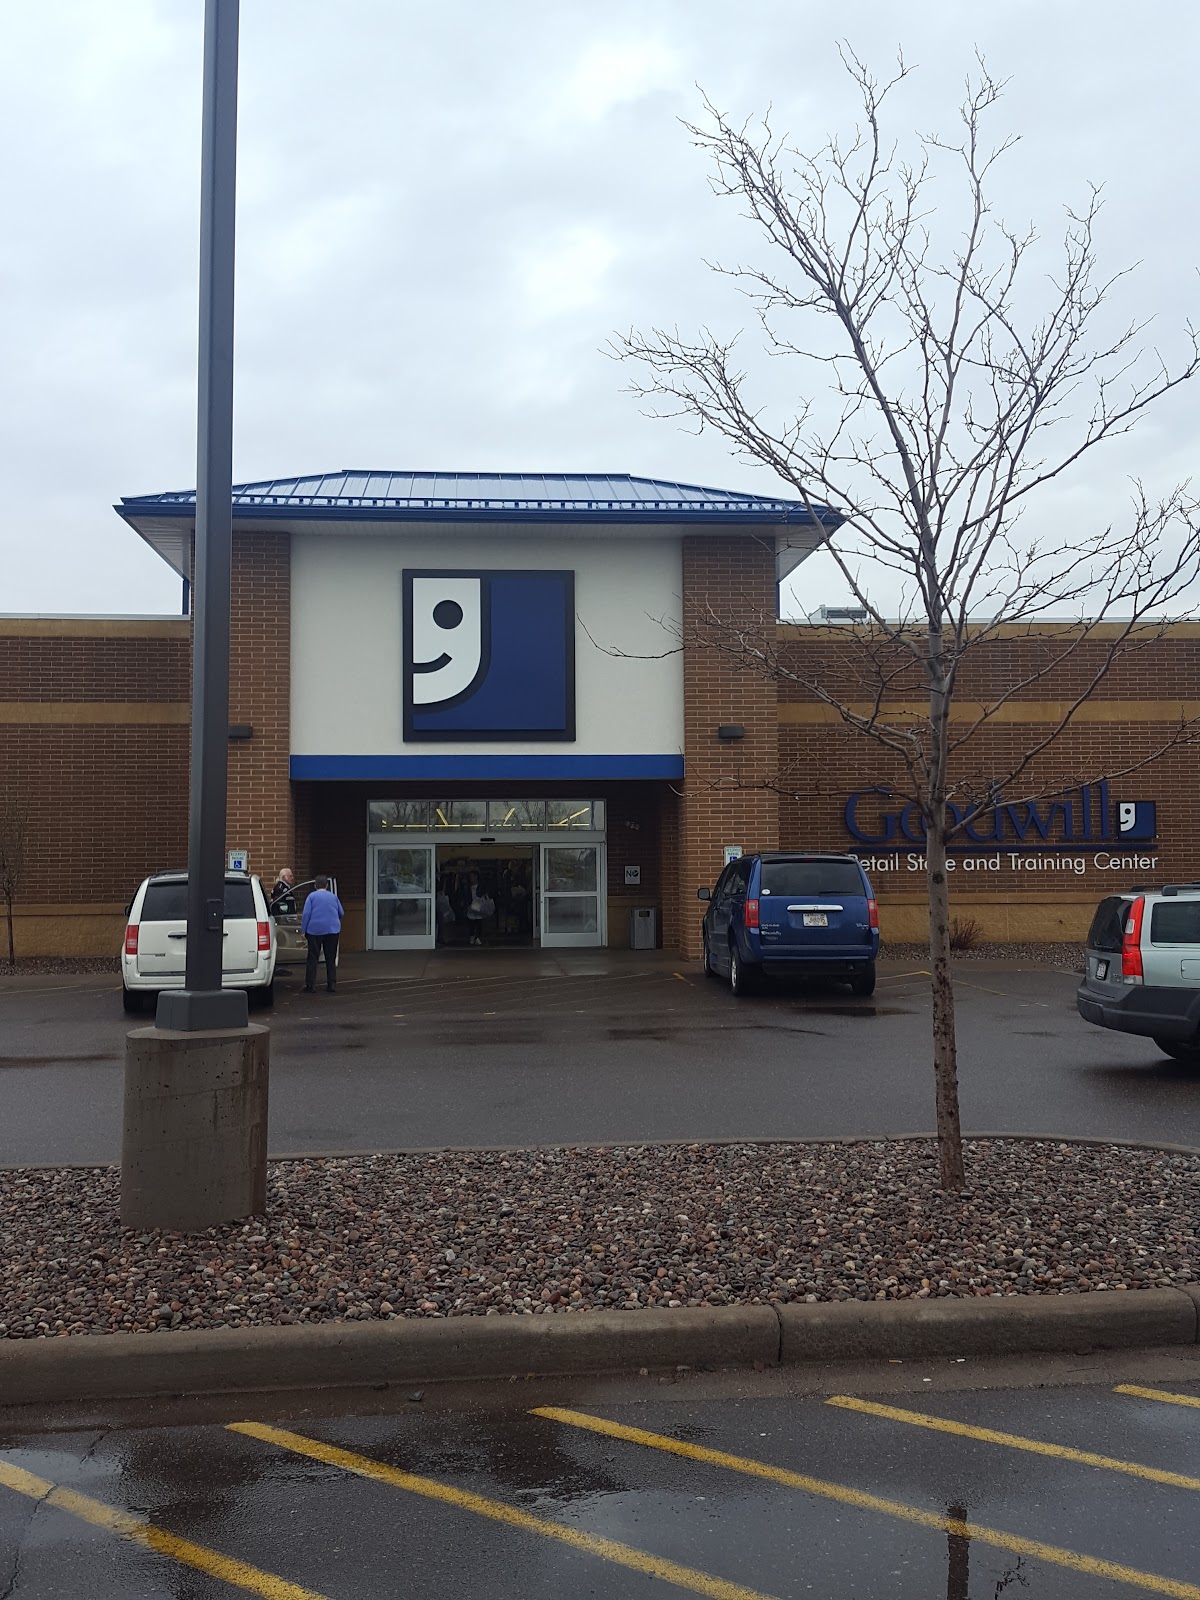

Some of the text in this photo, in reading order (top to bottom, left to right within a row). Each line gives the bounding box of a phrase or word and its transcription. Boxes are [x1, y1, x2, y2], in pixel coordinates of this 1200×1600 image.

[846, 780, 1108, 842] Goodwill
[848, 852, 1159, 874] etail Ste and Training Center
